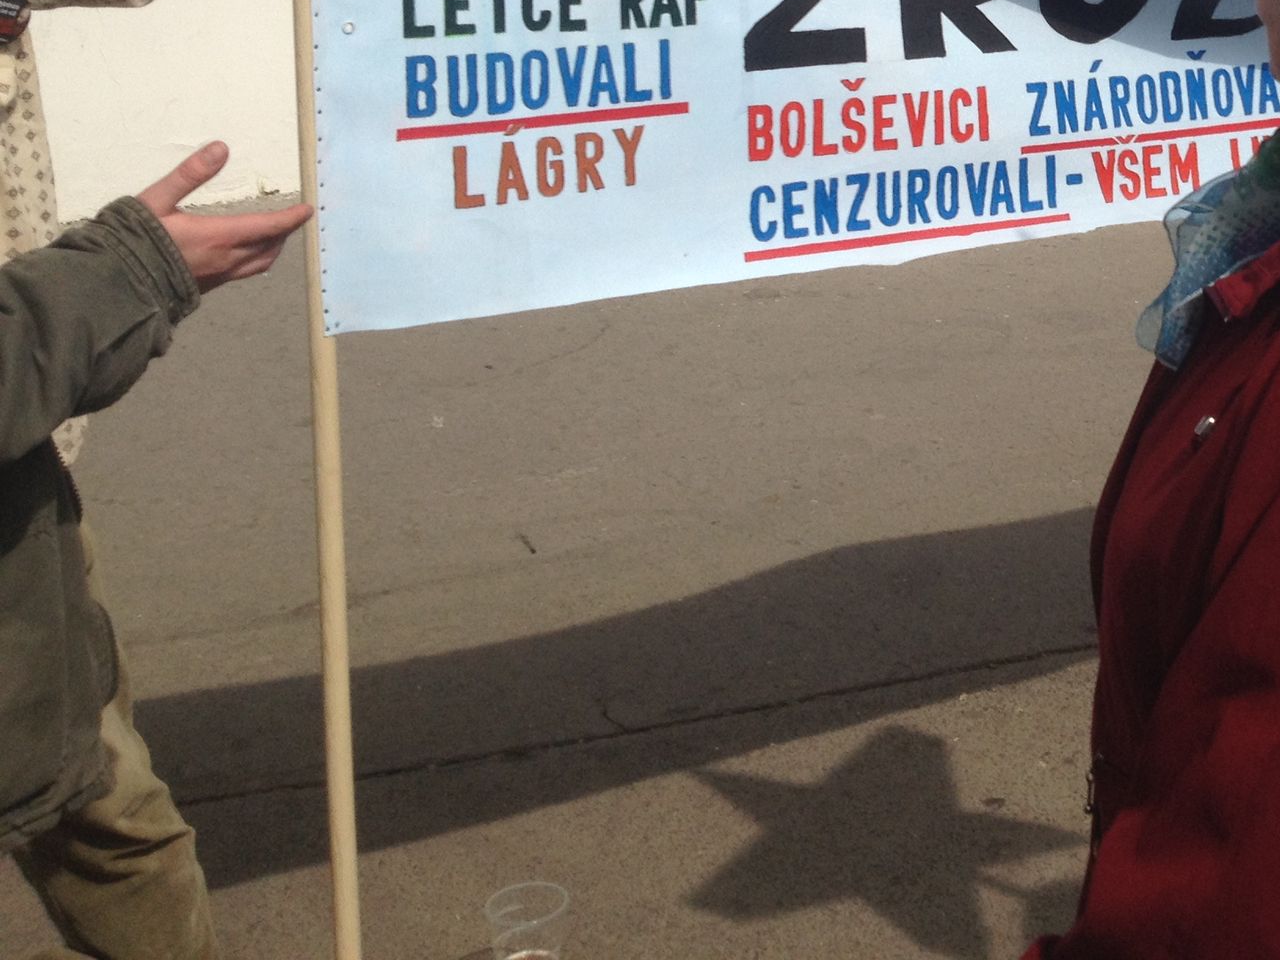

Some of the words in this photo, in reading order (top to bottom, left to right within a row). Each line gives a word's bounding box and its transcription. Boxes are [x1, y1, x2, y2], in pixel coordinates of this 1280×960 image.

[405, 39, 672, 119] BUDOVALI
[747, 78, 990, 162] BOLŠEVICI
[452, 124, 645, 210] LÁGRY
[1091, 135, 1201, 204] VŠEM
